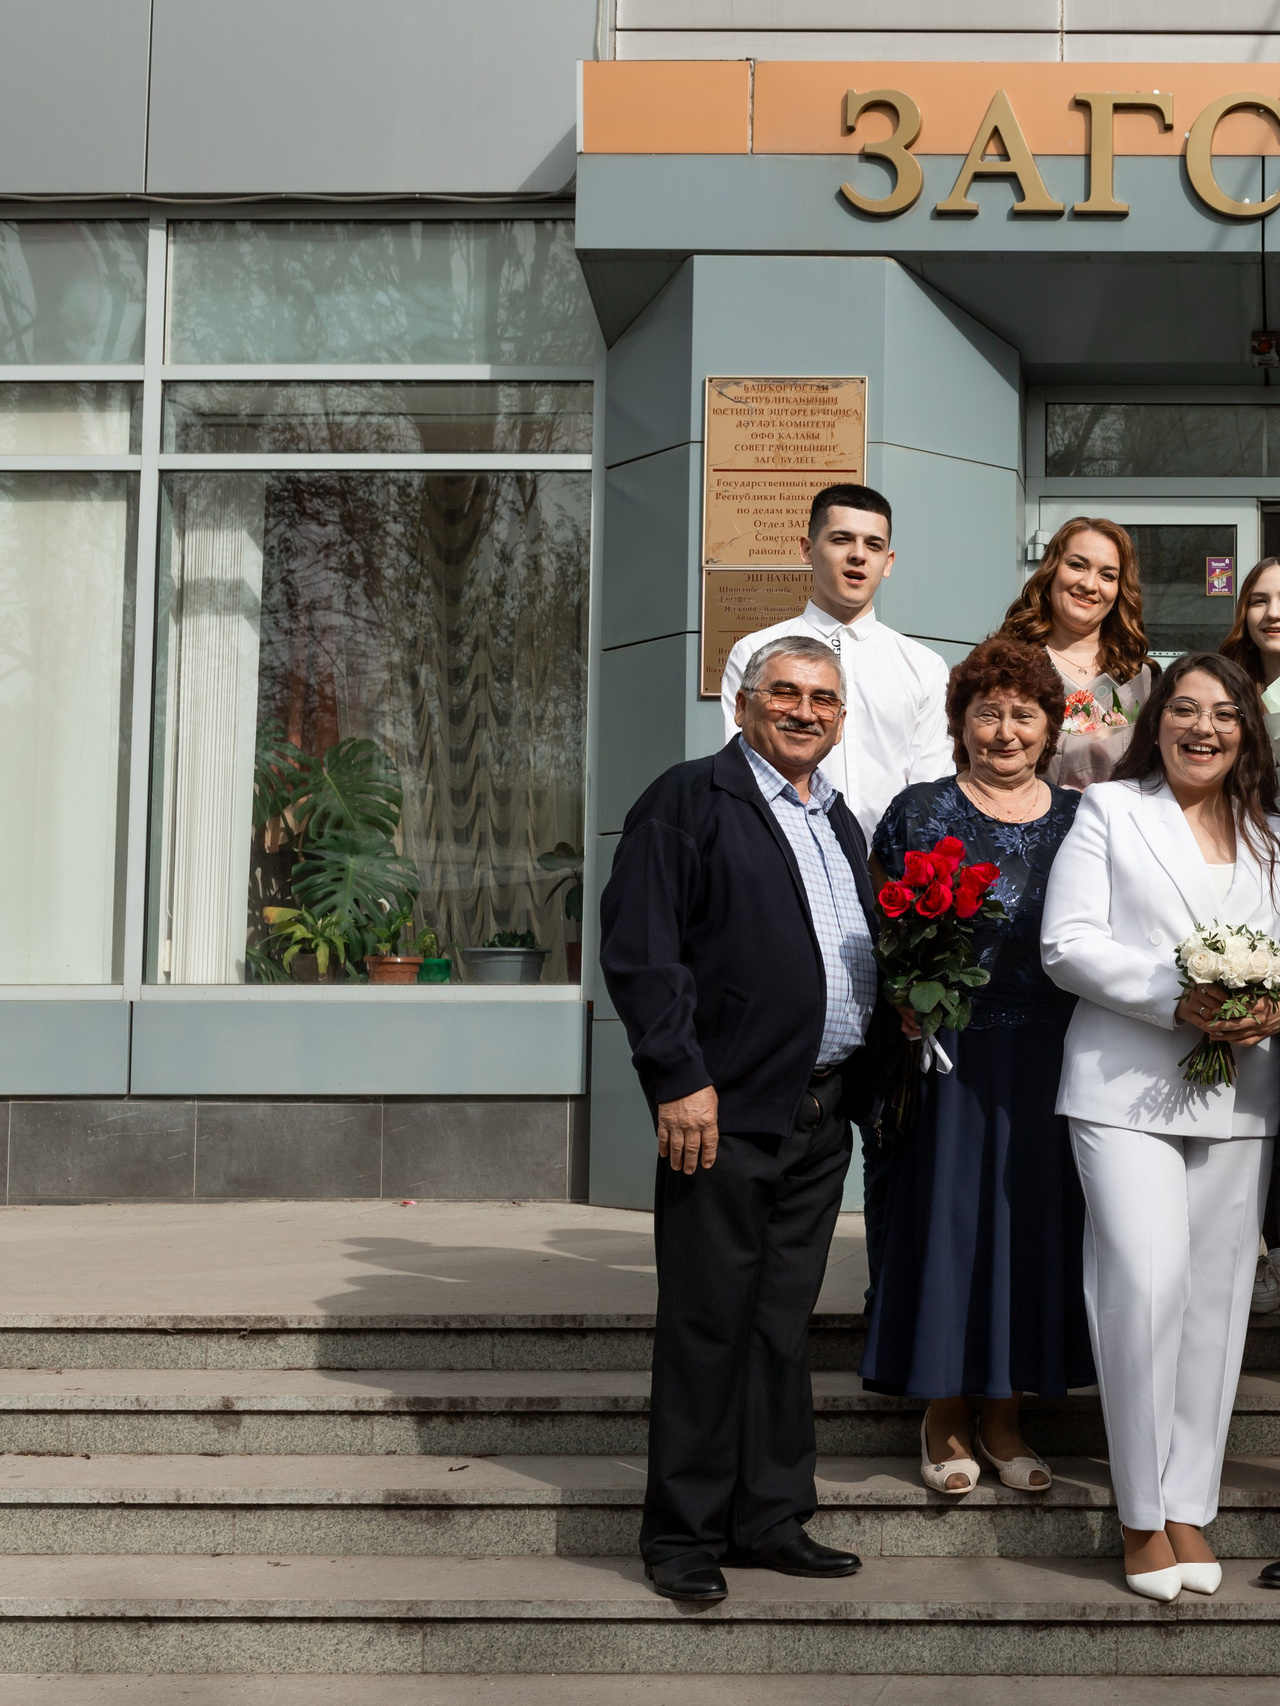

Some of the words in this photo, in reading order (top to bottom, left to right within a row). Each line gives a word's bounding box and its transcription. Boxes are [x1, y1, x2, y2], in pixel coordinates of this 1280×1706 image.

[712, 408, 764, 416] ЮСТИЦИЯ
[779, 420, 836, 428] КОМИТЕТЫ
[734, 444, 766, 452] СОВЕТ
[753, 456, 778, 464] ЗАГС
[716, 479, 807, 489] Государственный
[715, 492, 776, 503] Республики
[753, 520, 785, 528] Отдел
[748, 548, 786, 557] района
[743, 573, 763, 582] ЭШ
